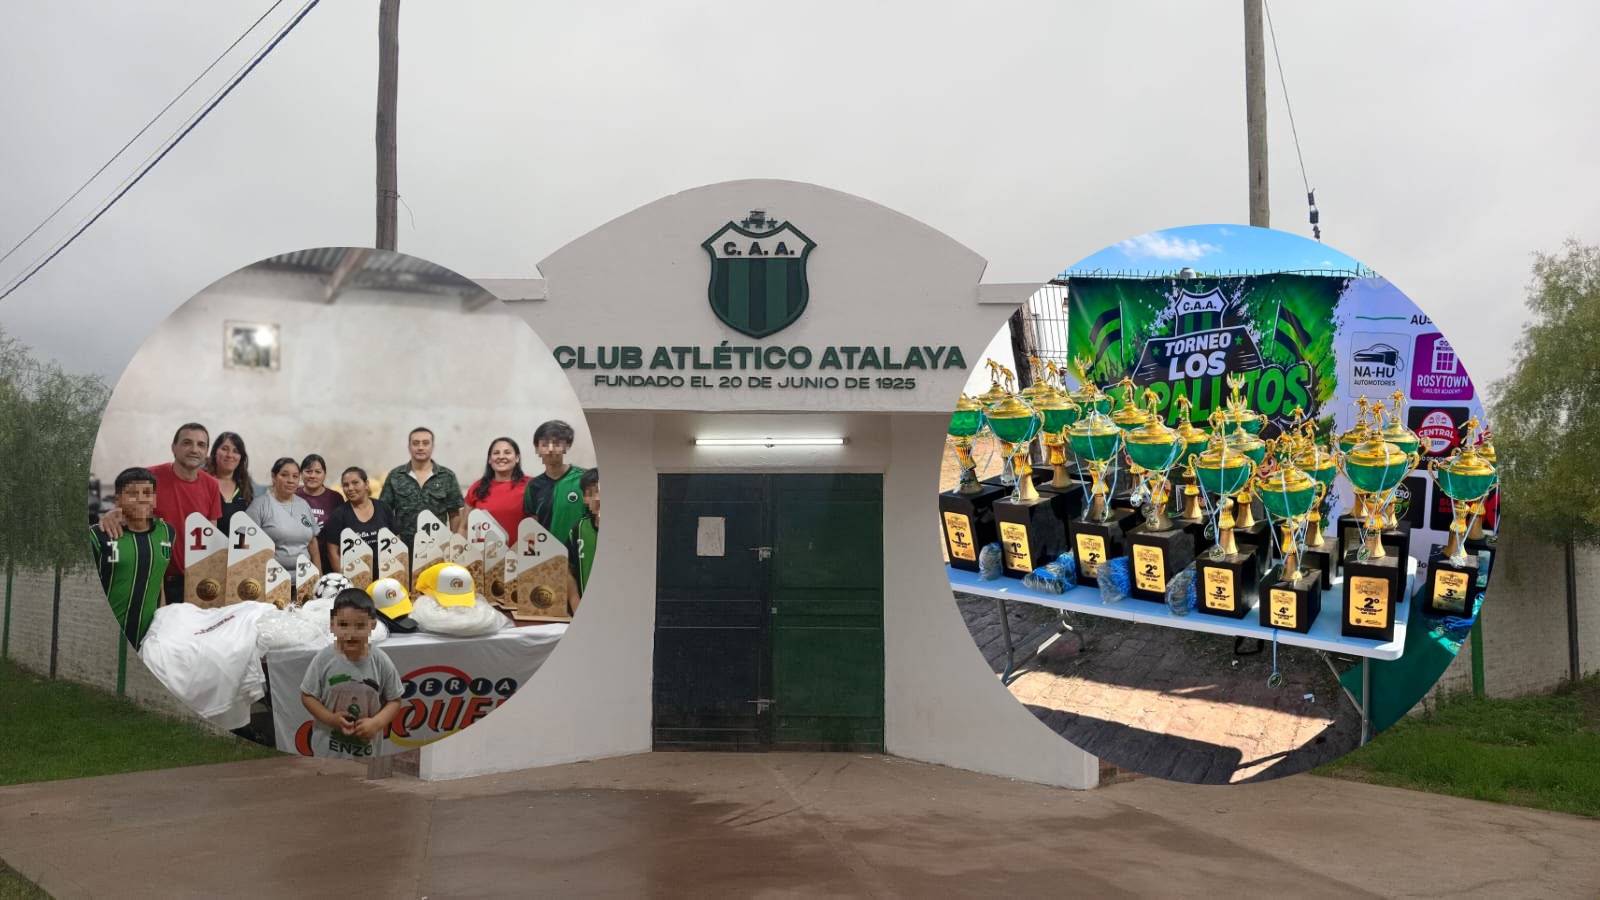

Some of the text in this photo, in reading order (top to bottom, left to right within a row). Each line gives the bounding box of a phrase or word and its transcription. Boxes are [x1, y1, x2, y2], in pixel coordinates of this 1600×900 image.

[1165, 332, 1231, 357] TORNEO
[553, 341, 967, 370] CLUB ATLÉTICO ATALAYA
[1168, 351, 1226, 381] LOS
[1354, 366, 1395, 378] NA-HU
[594, 375, 916, 390] FUNDADO EL 20 DE JUNIO DE 1925
[1354, 379, 1396, 387] AUTOMOTORES
[1417, 375, 1469, 387] ROSYTOWN
[1418, 428, 1454, 439] CENTRAL
[107, 541, 119, 562] 3
[329, 739, 373, 757] ENZO
